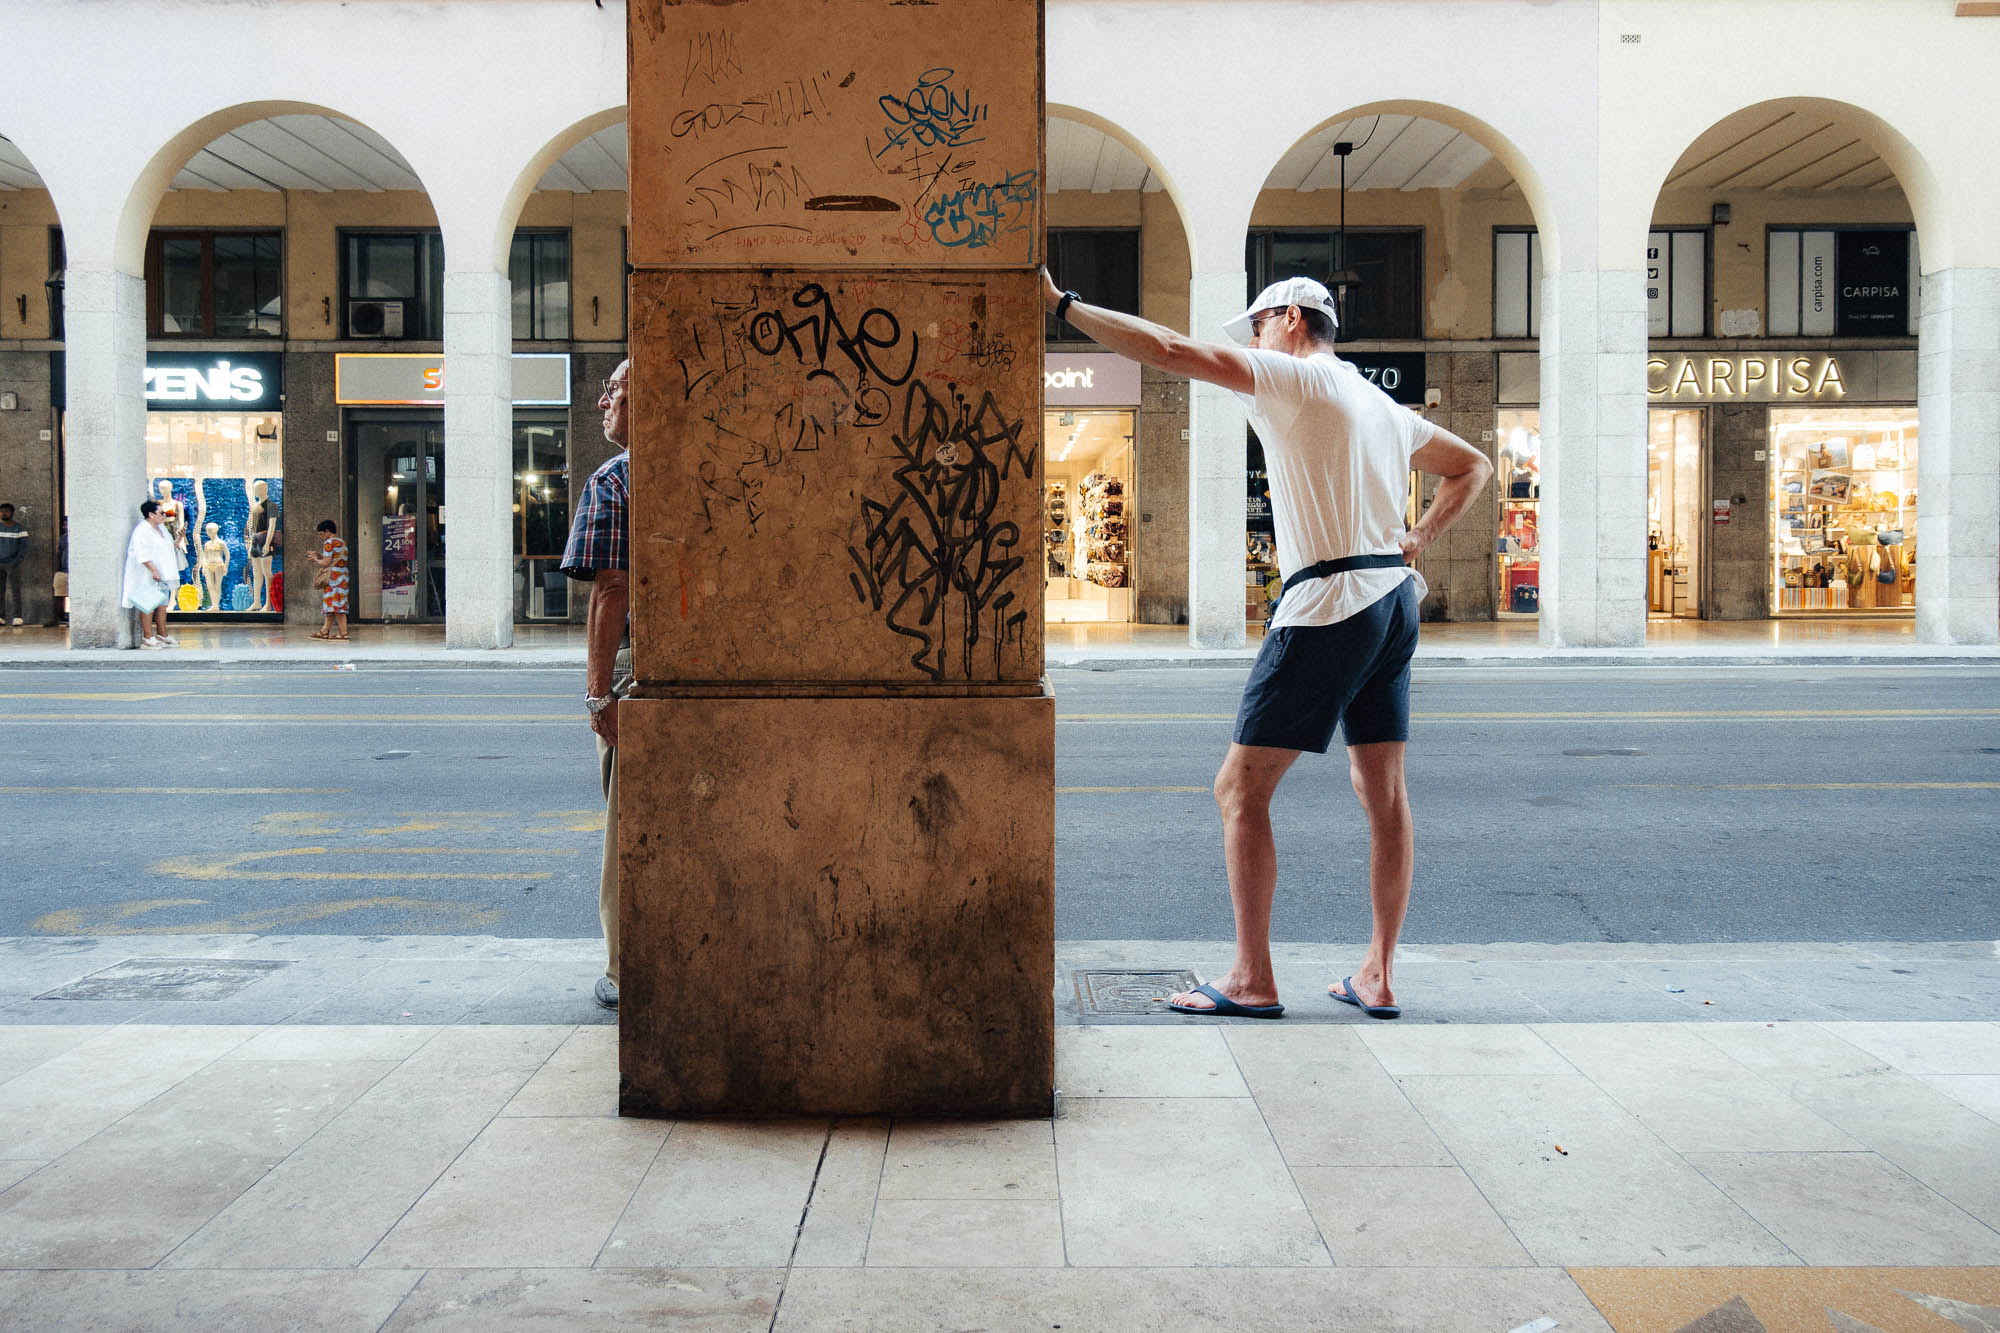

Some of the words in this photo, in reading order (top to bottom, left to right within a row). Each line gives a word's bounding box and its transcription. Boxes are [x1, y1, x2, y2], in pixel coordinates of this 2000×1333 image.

[1814, 256, 1825, 313] carpisa.com
[1843, 286, 1900, 298] CARPISA
[1647, 357, 1848, 396] CARPISA
